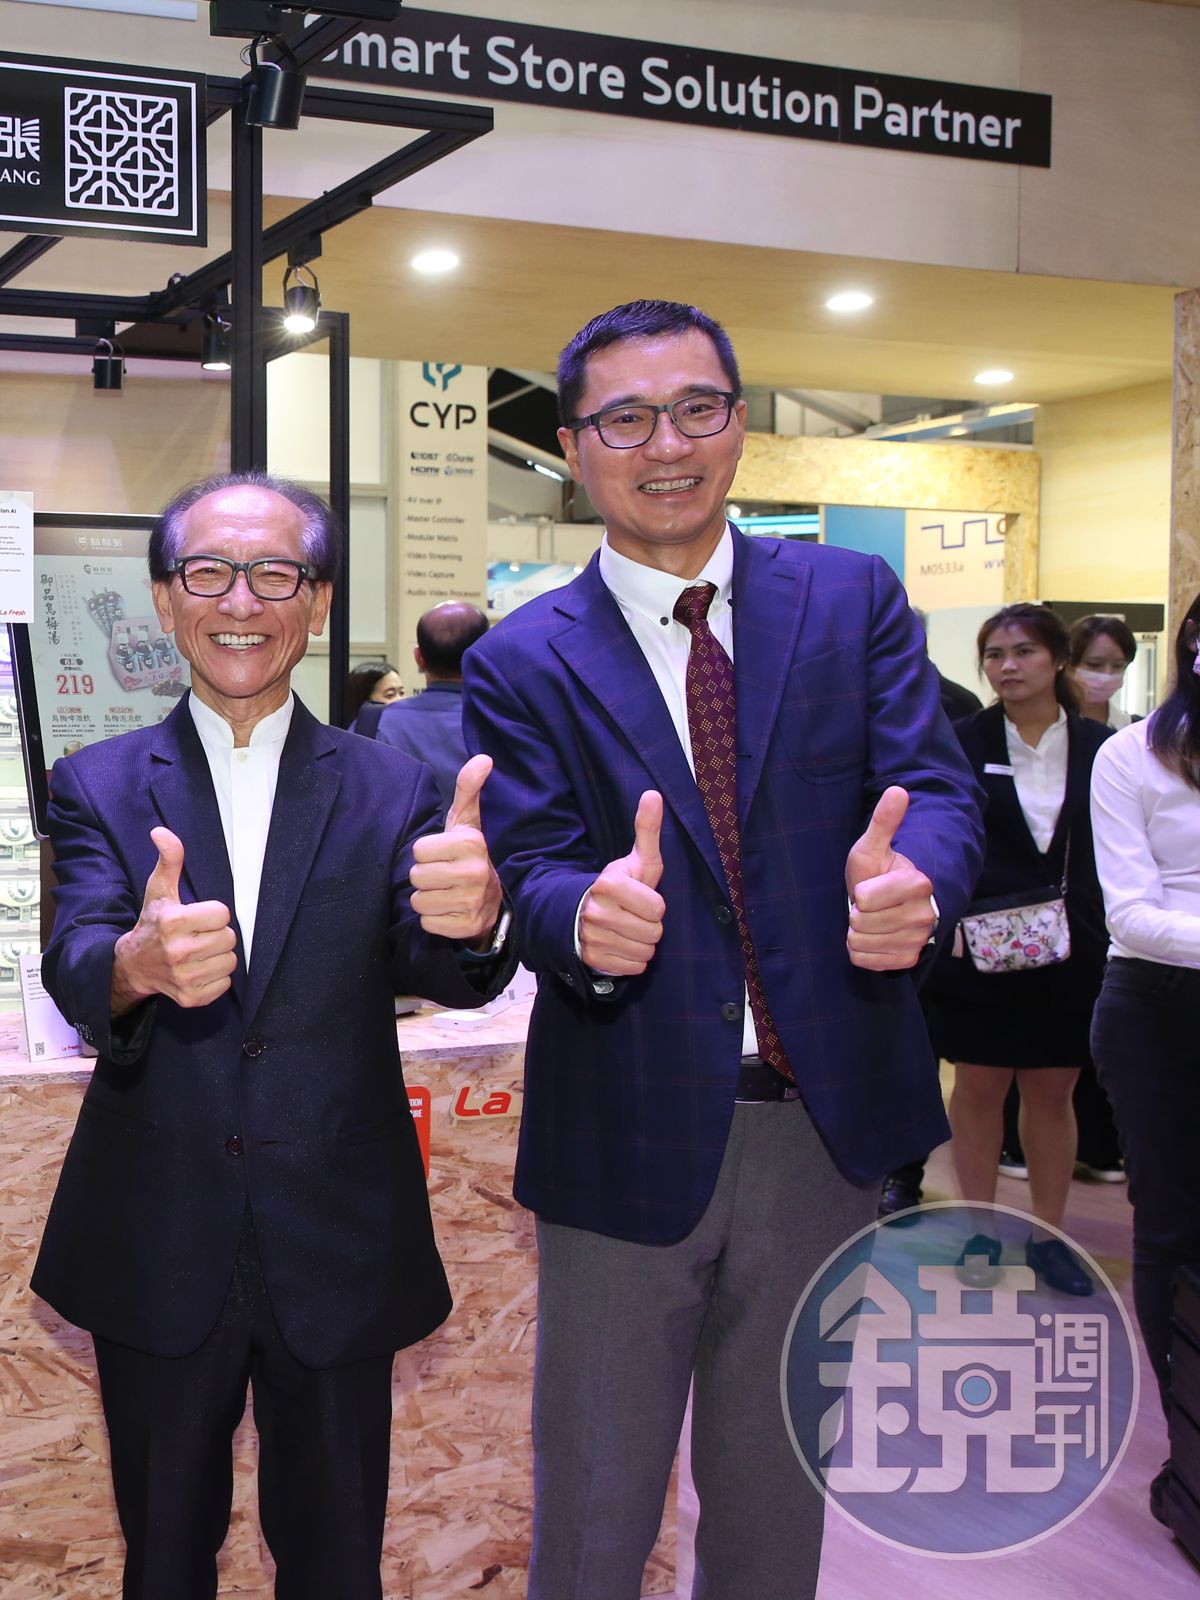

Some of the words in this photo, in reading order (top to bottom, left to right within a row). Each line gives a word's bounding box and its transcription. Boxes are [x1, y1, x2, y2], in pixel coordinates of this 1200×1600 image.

[485, 36, 626, 100] Store
[641, 56, 839, 127] Solution
[853, 84, 1022, 149] Partner
[409, 402, 477, 430] CYP
[56, 674, 95, 695] 219
[455, 1086, 512, 1117] La
